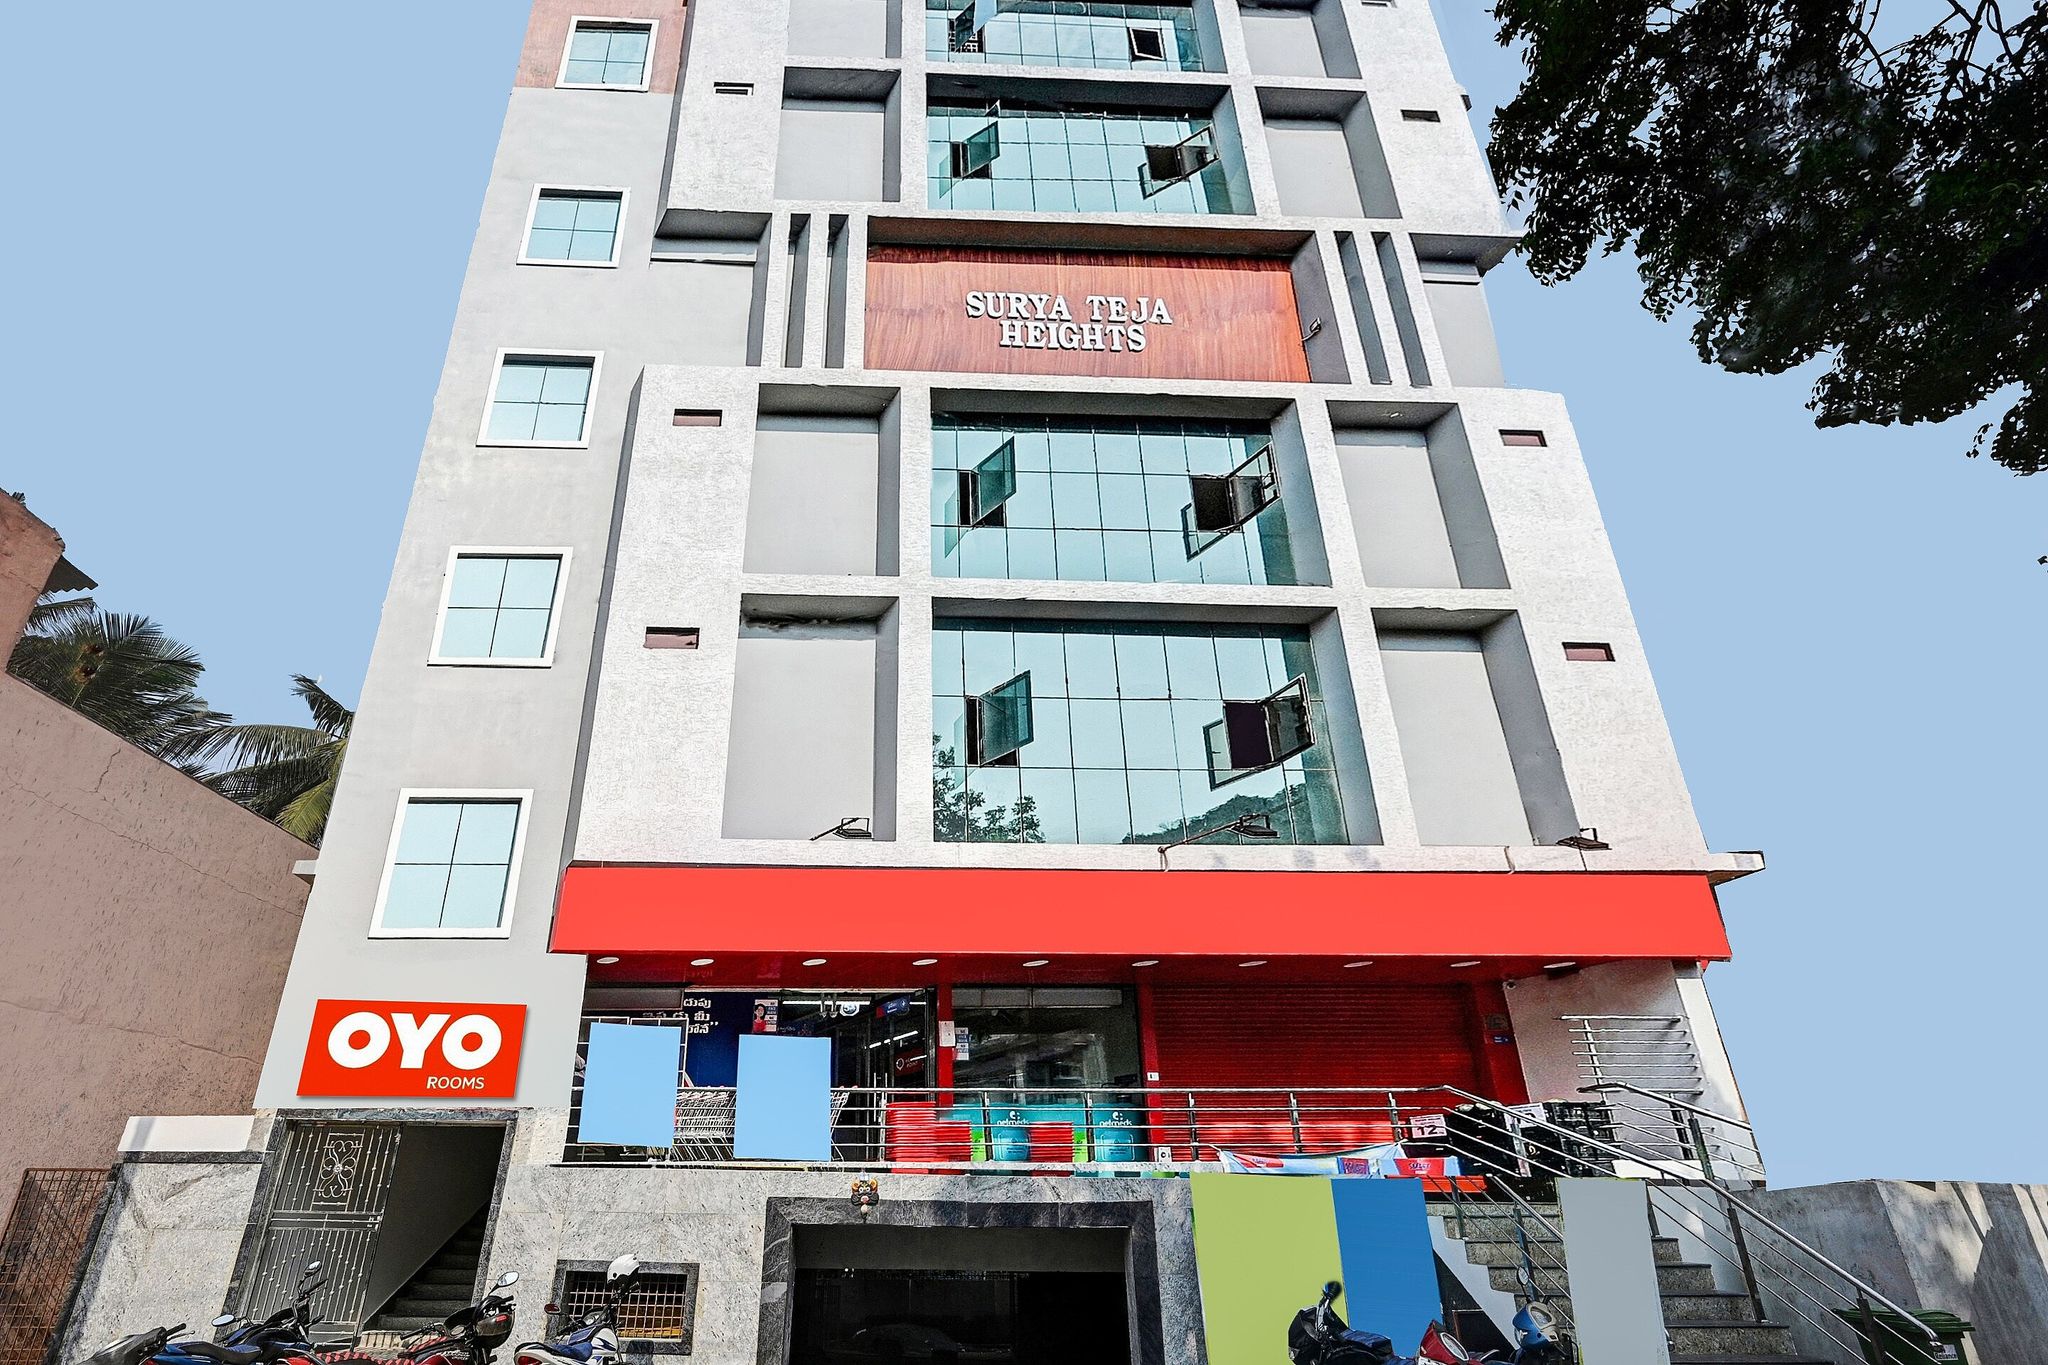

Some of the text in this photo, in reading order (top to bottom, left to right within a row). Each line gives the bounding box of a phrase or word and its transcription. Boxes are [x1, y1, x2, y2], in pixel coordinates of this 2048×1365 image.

[966, 291, 1173, 324] SURYA TEJA
[999, 320, 1147, 353] HEIGHTS
[328, 1011, 502, 1070] OYO
[426, 1076, 485, 1090] ROOMS
